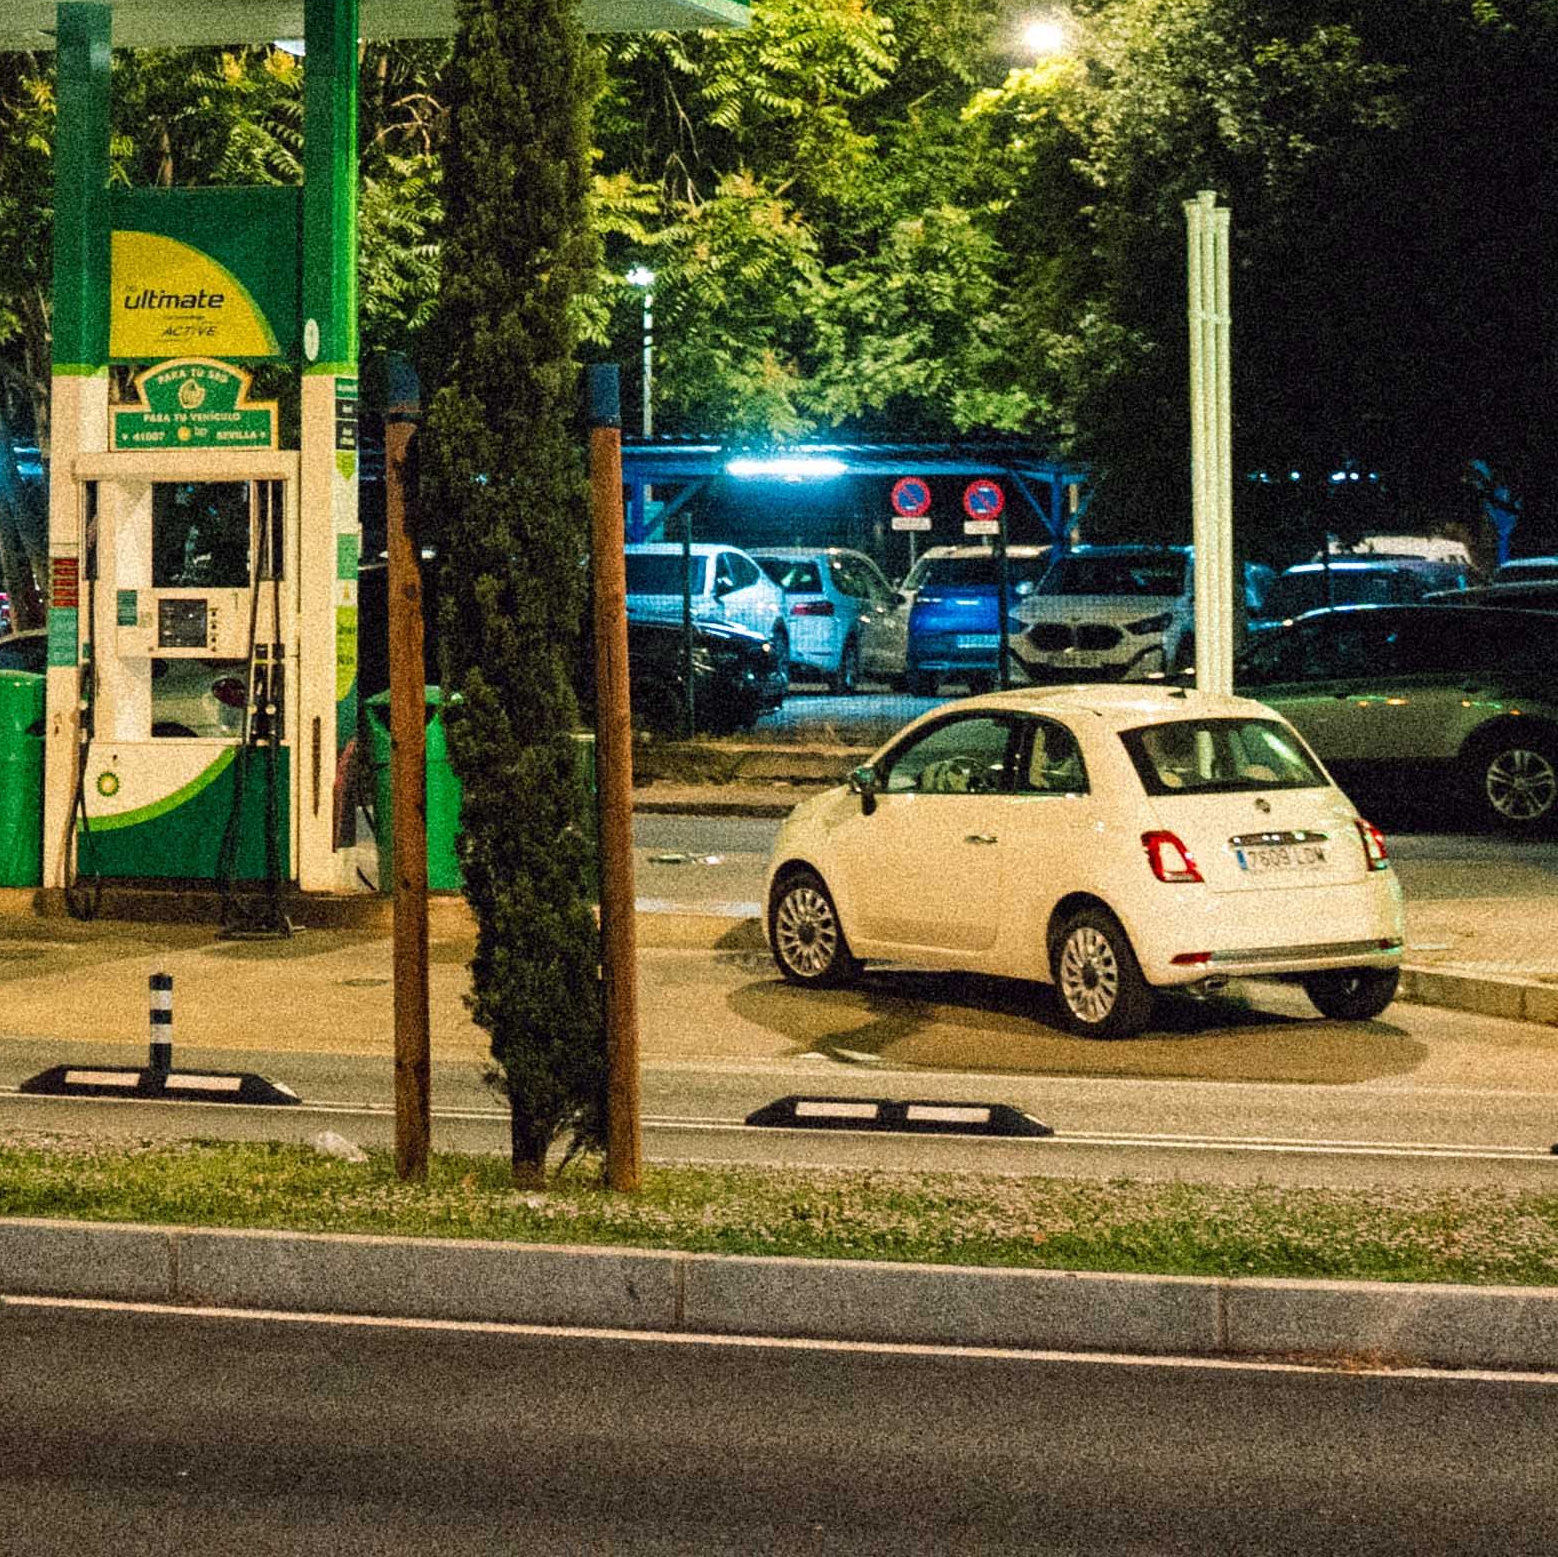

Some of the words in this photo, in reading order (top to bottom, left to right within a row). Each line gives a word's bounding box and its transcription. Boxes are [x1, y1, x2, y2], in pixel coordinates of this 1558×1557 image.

[124, 288, 225, 310] ultimate
[161, 325, 218, 337] ACTIVE
[157, 369, 187, 385] PARA
[143, 413, 171, 423] PARA
[174, 413, 187, 423] TU
[216, 431, 258, 441] SEVILLA
